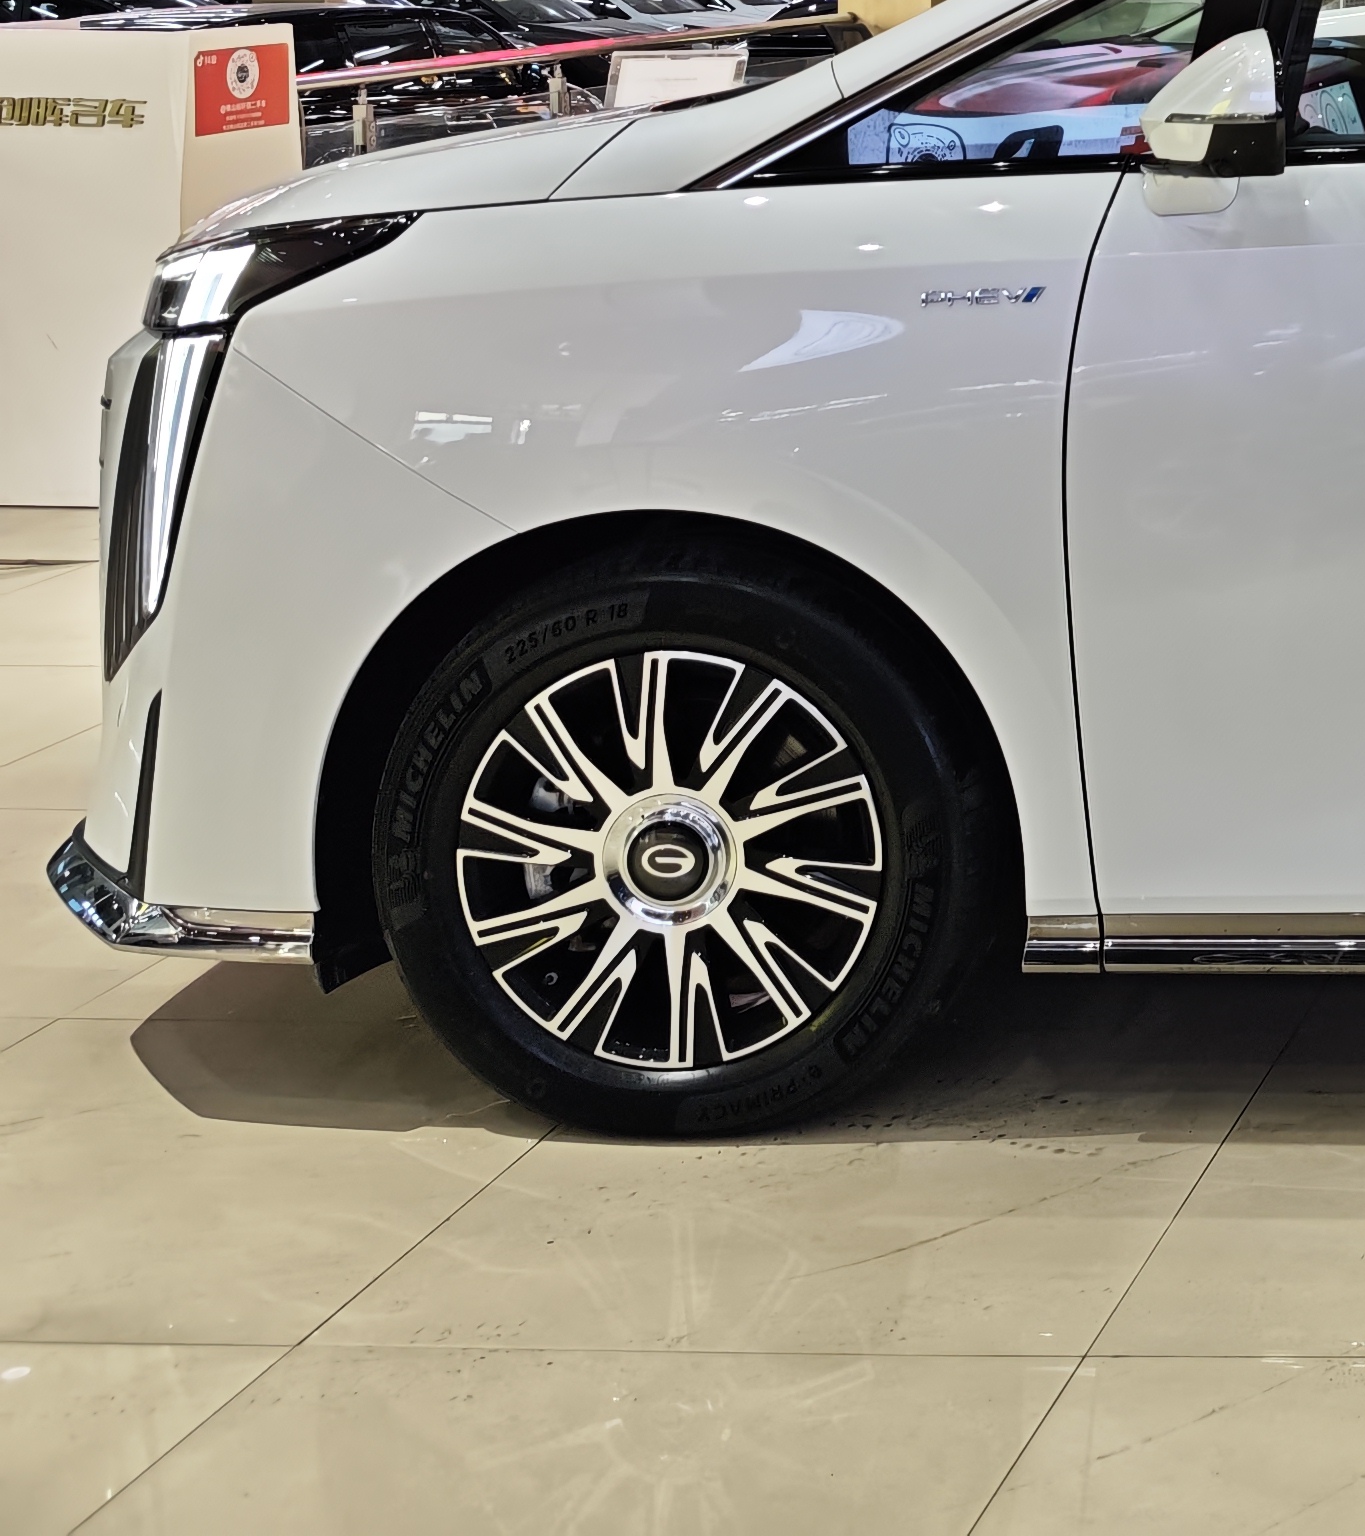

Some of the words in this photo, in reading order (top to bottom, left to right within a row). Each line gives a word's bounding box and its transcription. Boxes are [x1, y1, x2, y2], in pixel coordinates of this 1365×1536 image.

[0, 97, 147, 128] 创晖名车
[920, 286, 1027, 308] PHEV
[503, 615, 577, 665] 225/60
[586, 608, 599, 626] R
[608, 602, 629, 622] 18
[392, 667, 485, 843] MICHELIN
[842, 884, 936, 1056] MICHELIN
